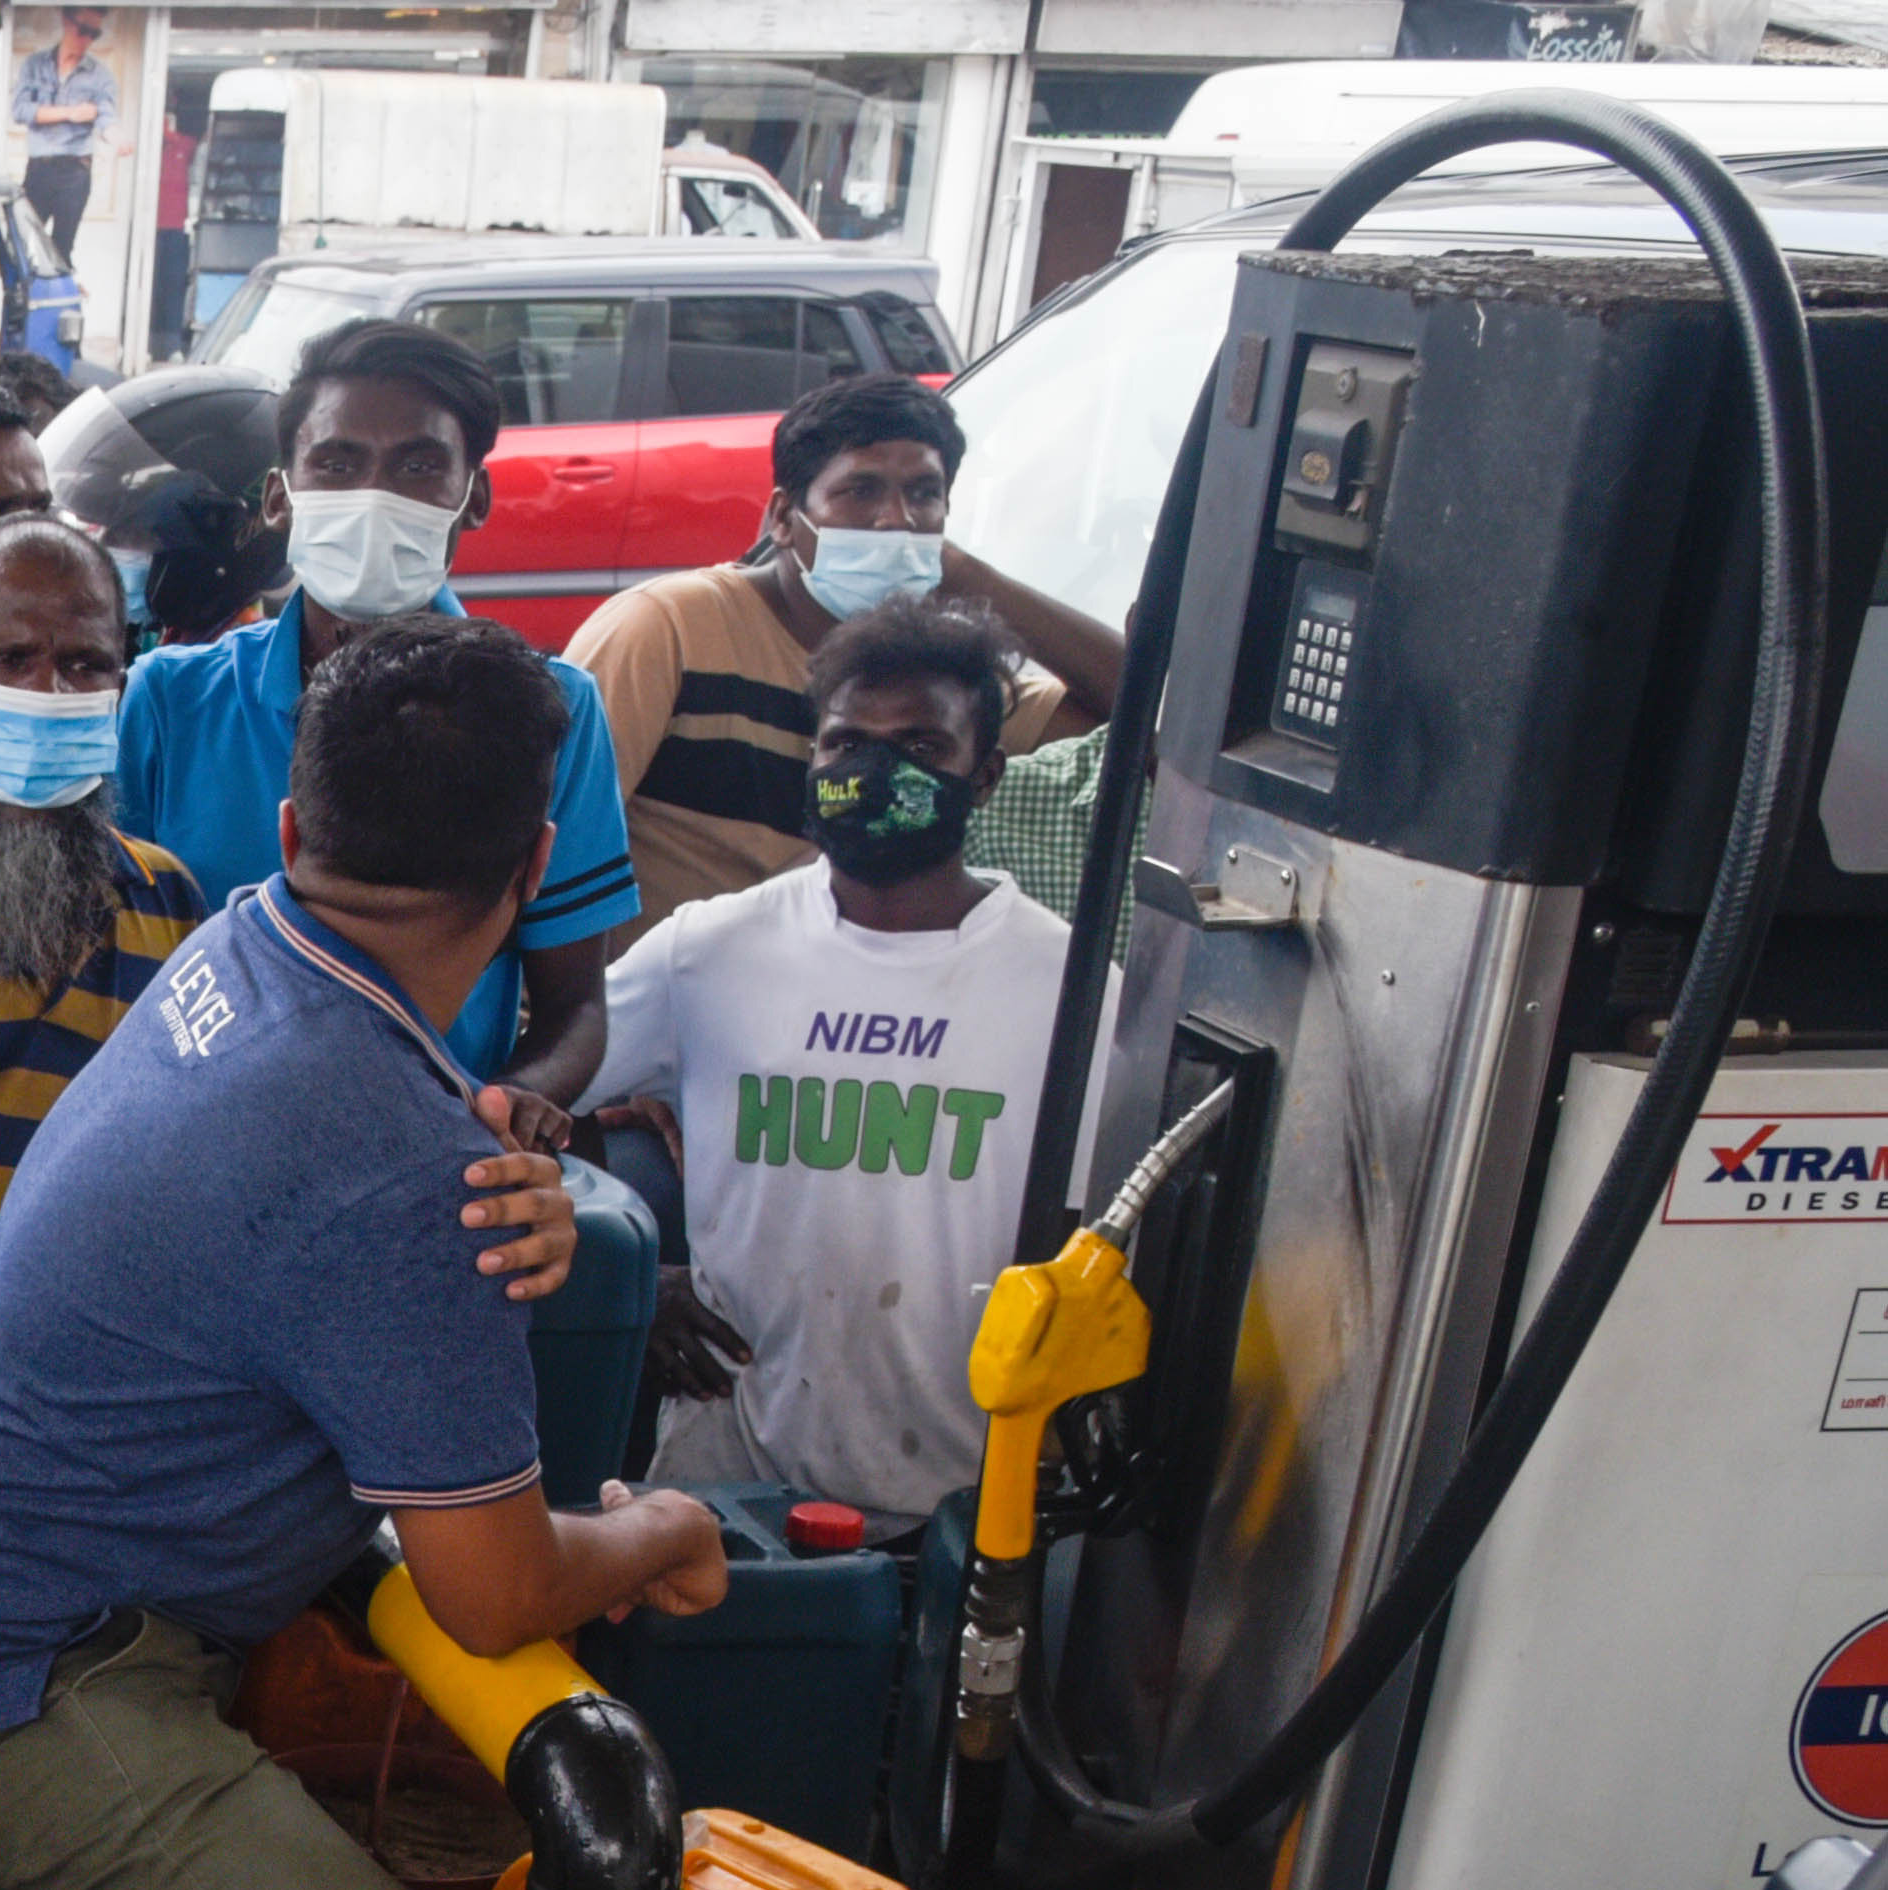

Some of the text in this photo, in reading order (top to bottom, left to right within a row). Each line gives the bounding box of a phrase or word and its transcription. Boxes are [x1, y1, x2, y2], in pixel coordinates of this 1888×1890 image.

[170, 948, 235, 1056] LEVEL
[805, 1011, 950, 1059] NIBM
[735, 1073, 1006, 1181] HUNT
